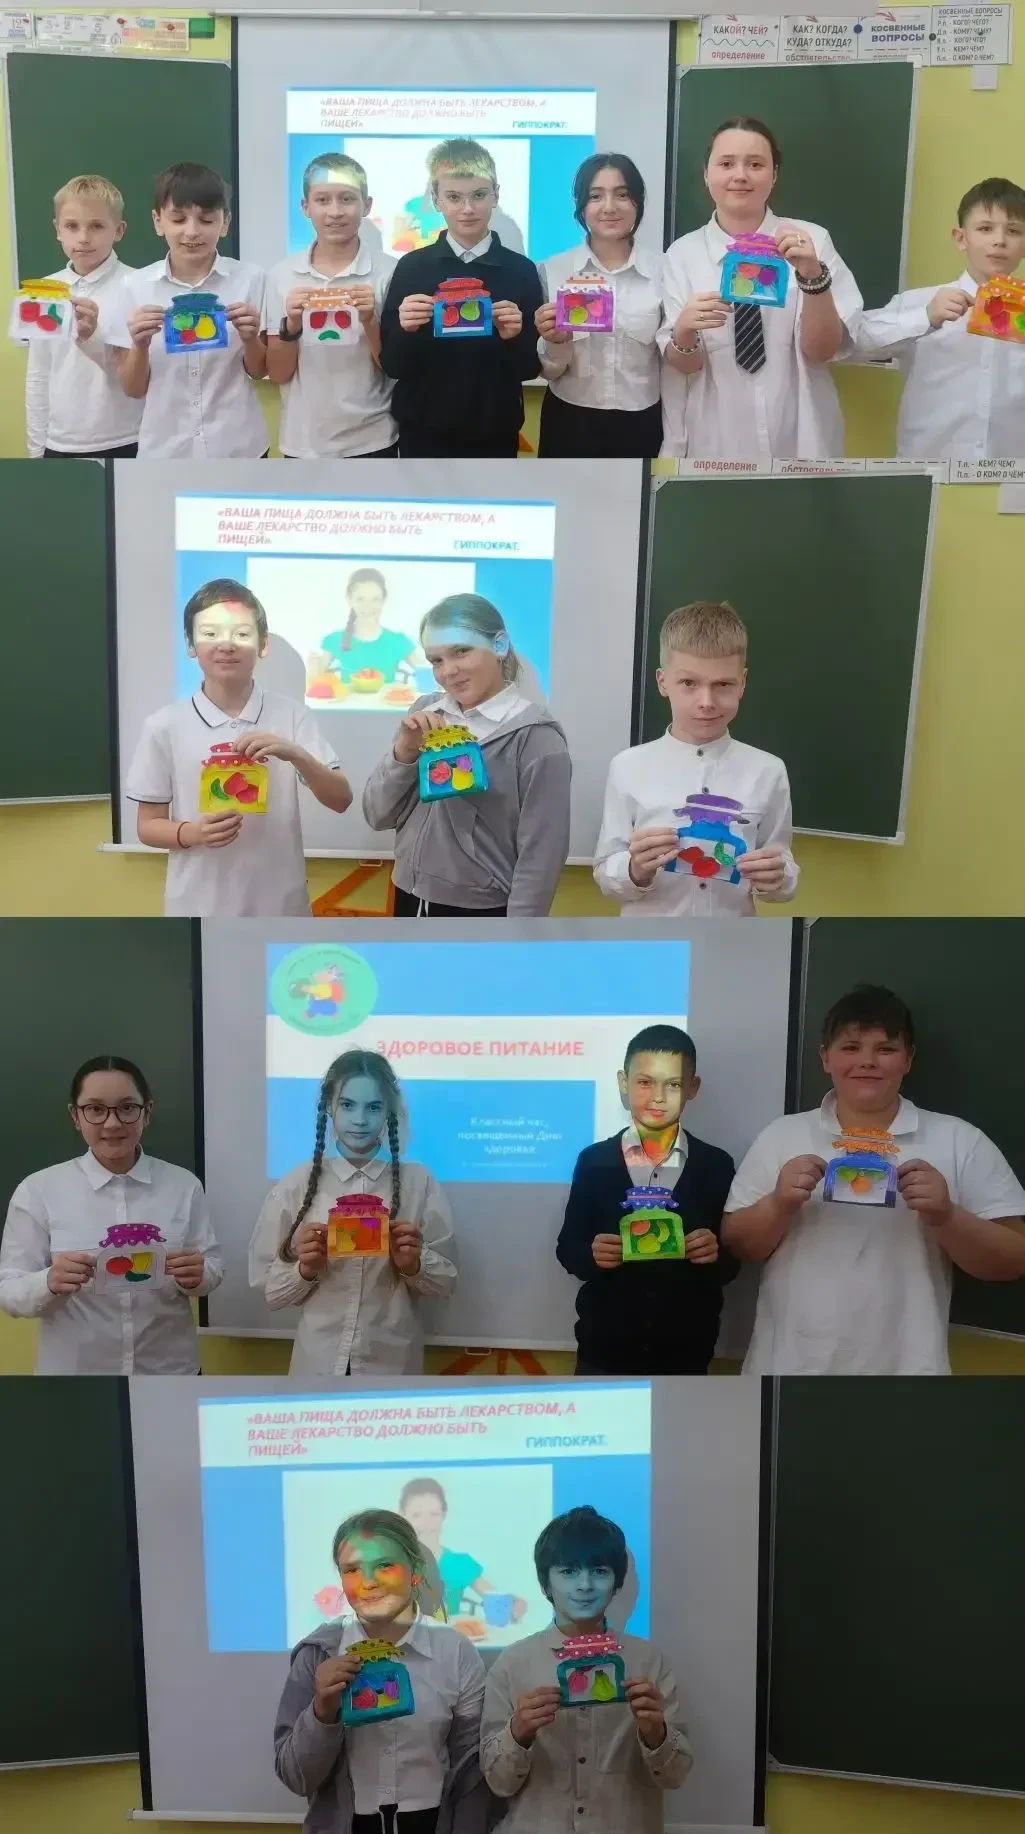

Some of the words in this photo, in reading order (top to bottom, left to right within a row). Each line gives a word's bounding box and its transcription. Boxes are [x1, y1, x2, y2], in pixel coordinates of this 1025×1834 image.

[713, 24, 746, 35] КАКОЙ?
[748, 25, 769, 36] ЧЕЙ?
[792, 24, 814, 34] КАК?
[815, 24, 848, 35] КОГДА?
[871, 24, 926, 32] КОСВЕННЫЕ
[786, 37, 814, 48] КУДА?
[815, 37, 852, 48] ОТКУДА?
[871, 33, 925, 43] ВОПРОСЫ
[711, 51, 766, 61] определение
[320, 97, 356, 107] «ВАША
[357, 97, 389, 108] ПИЩА
[439, 98, 466, 108] БЫТЬ
[693, 460, 758, 472] определение
[978, 460, 996, 468] КЕМ?
[998, 460, 1016, 468] ЧЕМ?
[983, 470, 1002, 478] КОМ?
[217, 507, 261, 518] «ВАША
[263, 508, 302, 521] ПИЩА
[304, 509, 361, 521] ДОЛЖНА
[363, 510, 398, 521] БЫТЬ
[487, 514, 496, 524] А
[217, 520, 253, 531] ВАШЕ
[255, 521, 328, 532] ЛЕКАРСТВО
[328, 523, 386, 535] ДОЛЖНО
[388, 524, 423, 536] БЫТЬ
[217, 531, 272, 547] ПИЩЕЙ»
[454, 540, 520, 551] ГИППОКРАТ.
[376, 1040, 483, 1058] ЗДОРОВОЕ
[489, 1041, 585, 1056] ПИТАНИЕ
[247, 1412, 295, 1425] «ВАША
[299, 1410, 344, 1425] ПИЩА
[346, 1407, 412, 1424] ДОЛЖНА
[416, 1406, 456, 1419] БЫТЬ
[458, 1402, 563, 1418] ЛЕКАРСТВОМ,
[566, 1402, 577, 1413] А
[247, 1428, 288, 1441] ВАШЕ
[291, 1425, 374, 1440] ЛЕКАРСТВО
[375, 1423, 444, 1440] ДОЛЖНО
[447, 1422, 488, 1435] БЫТЬ
[525, 1434, 609, 1449] ГИППОКРАТ.
[248, 1439, 309, 1460] ПИЩЕЙ»
